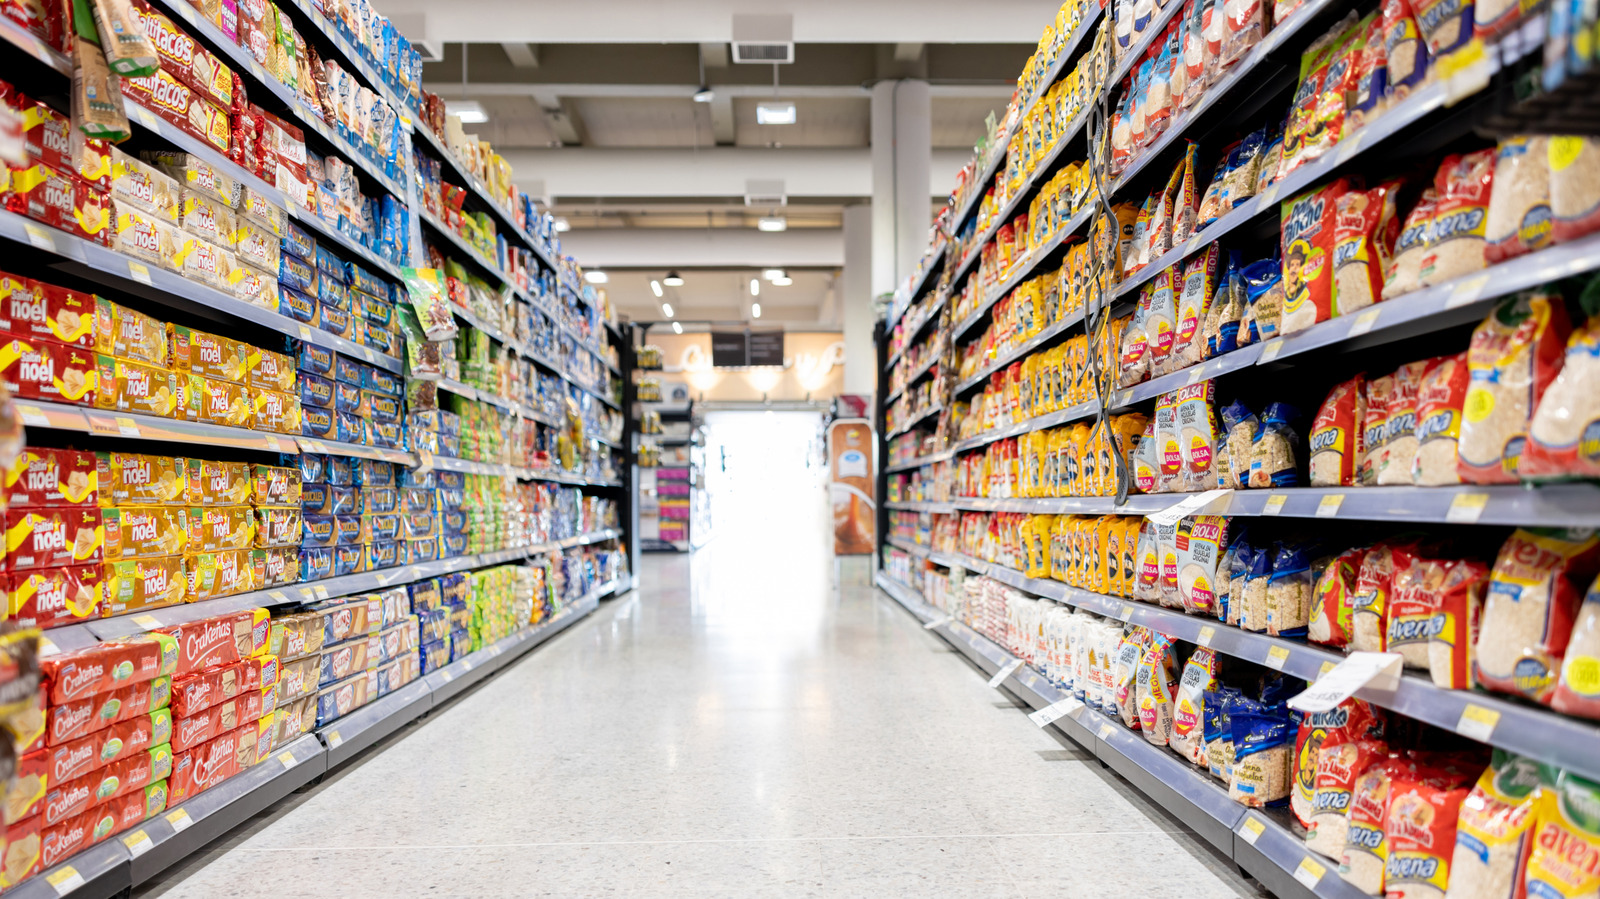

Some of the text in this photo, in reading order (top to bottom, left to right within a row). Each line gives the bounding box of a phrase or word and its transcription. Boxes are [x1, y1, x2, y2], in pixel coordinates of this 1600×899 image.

[45, 187, 75, 211] noel
[130, 179, 153, 202] noel
[1184, 173, 1194, 206] GRATIS
[197, 213, 216, 231] noel
[134, 230, 160, 251] noel
[197, 256, 216, 272] noel
[1303, 256, 1326, 276] BOLSA
[1203, 281, 1214, 310] MEGA
[10, 297, 47, 322] noel
[122, 319, 143, 341] noel
[200, 345, 221, 364] noel
[1129, 343, 1144, 353] BOLSA
[20, 358, 54, 382] noel
[261, 358, 278, 375] noel
[126, 371, 149, 397] noel
[1207, 410, 1219, 437] MEGA
[1165, 455, 1181, 463] BOLSA
[1192, 450, 1209, 461] BOLSA
[28, 465, 60, 490] noel
[123, 462, 150, 485] noel
[210, 470, 229, 491] noel
[272, 477, 288, 495] noel
[132, 517, 157, 542] noel
[213, 516, 230, 537] noel
[1203, 515, 1221, 525] MEGA
[33, 524, 66, 551] noel
[1191, 524, 1220, 540] BOLSA
[1143, 566, 1158, 574] BOLSA
[144, 569, 167, 595] noel
[36, 582, 68, 612] noel
[1192, 588, 1210, 601] BOLSA
[186, 621, 231, 661] Crakeñas
[288, 632, 305, 654] noel
[63, 664, 104, 696] Crakeñas
[287, 669, 304, 696] noel
[285, 711, 302, 737] noel
[1538, 822, 1600, 878] aven
[1386, 853, 1438, 878] Avena
